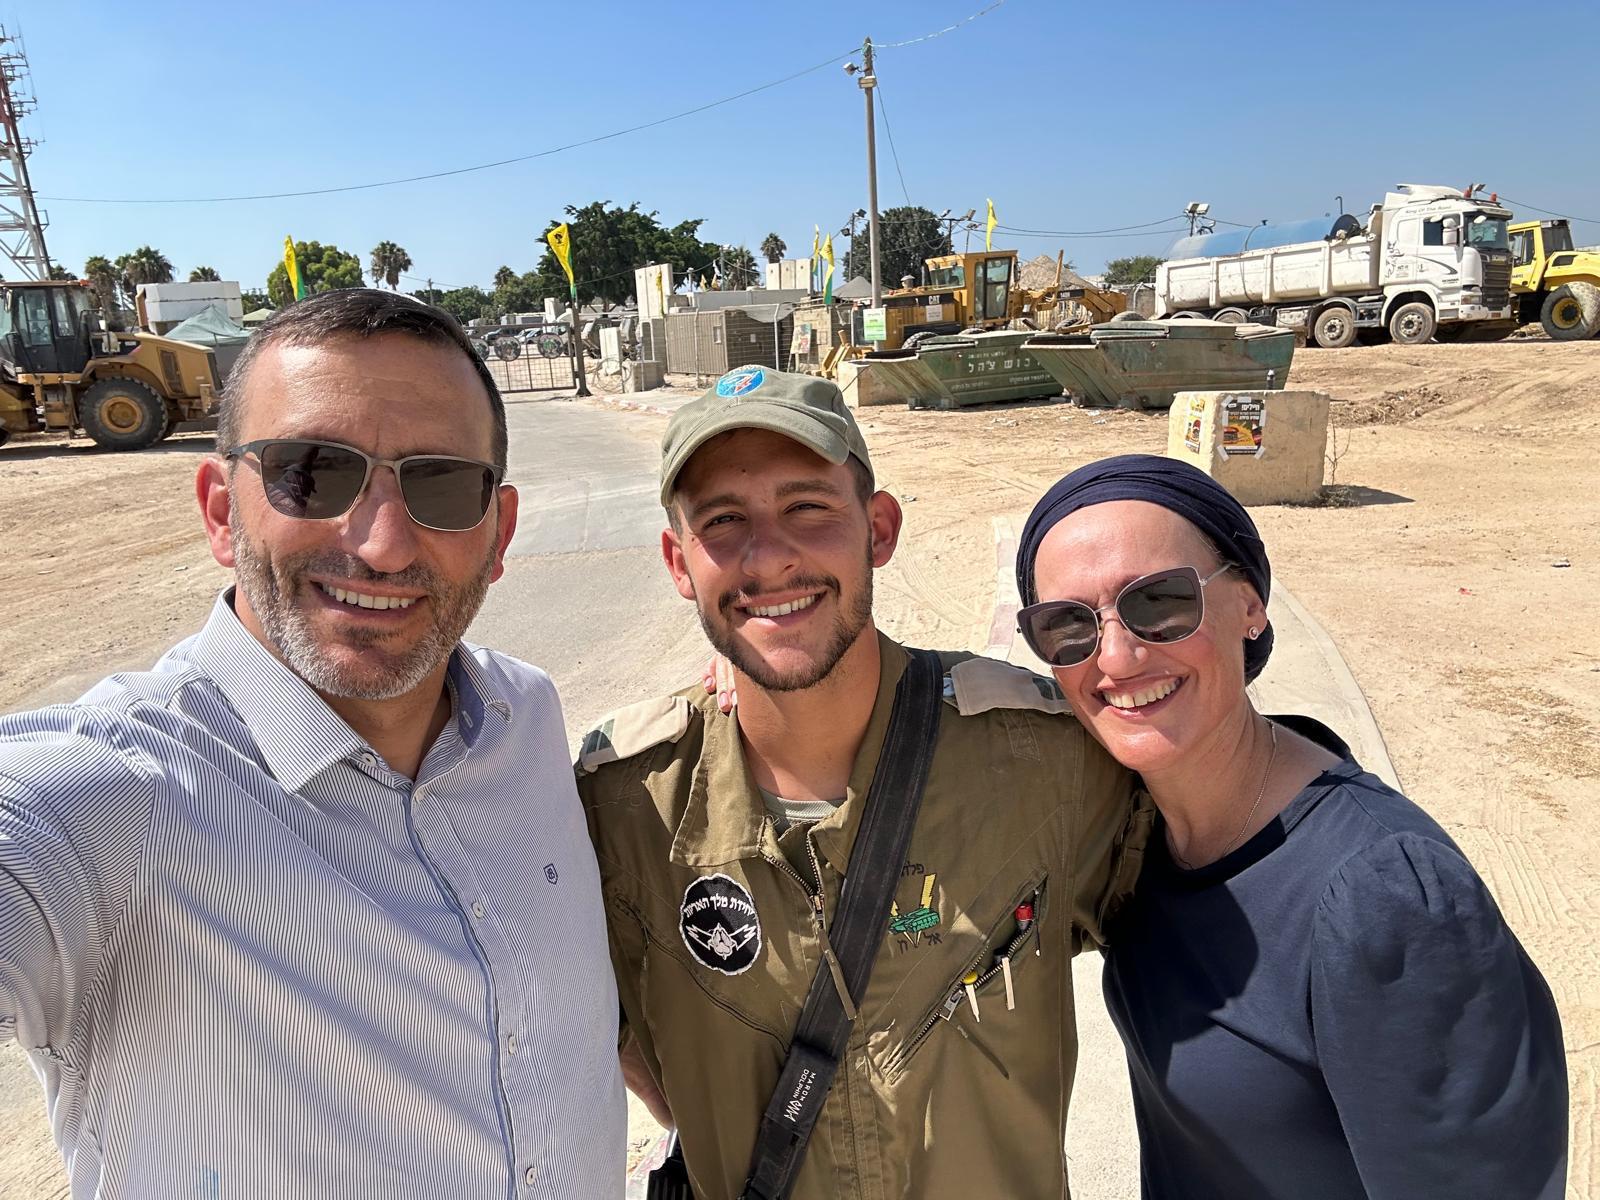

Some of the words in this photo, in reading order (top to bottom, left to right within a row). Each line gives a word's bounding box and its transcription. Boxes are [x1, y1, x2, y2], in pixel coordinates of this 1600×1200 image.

[928, 295, 940, 304] CAT
[710, 892, 728, 911] מלך
[793, 1068, 810, 1099] DOLPHIN
[800, 1072, 816, 1101] MAROM
